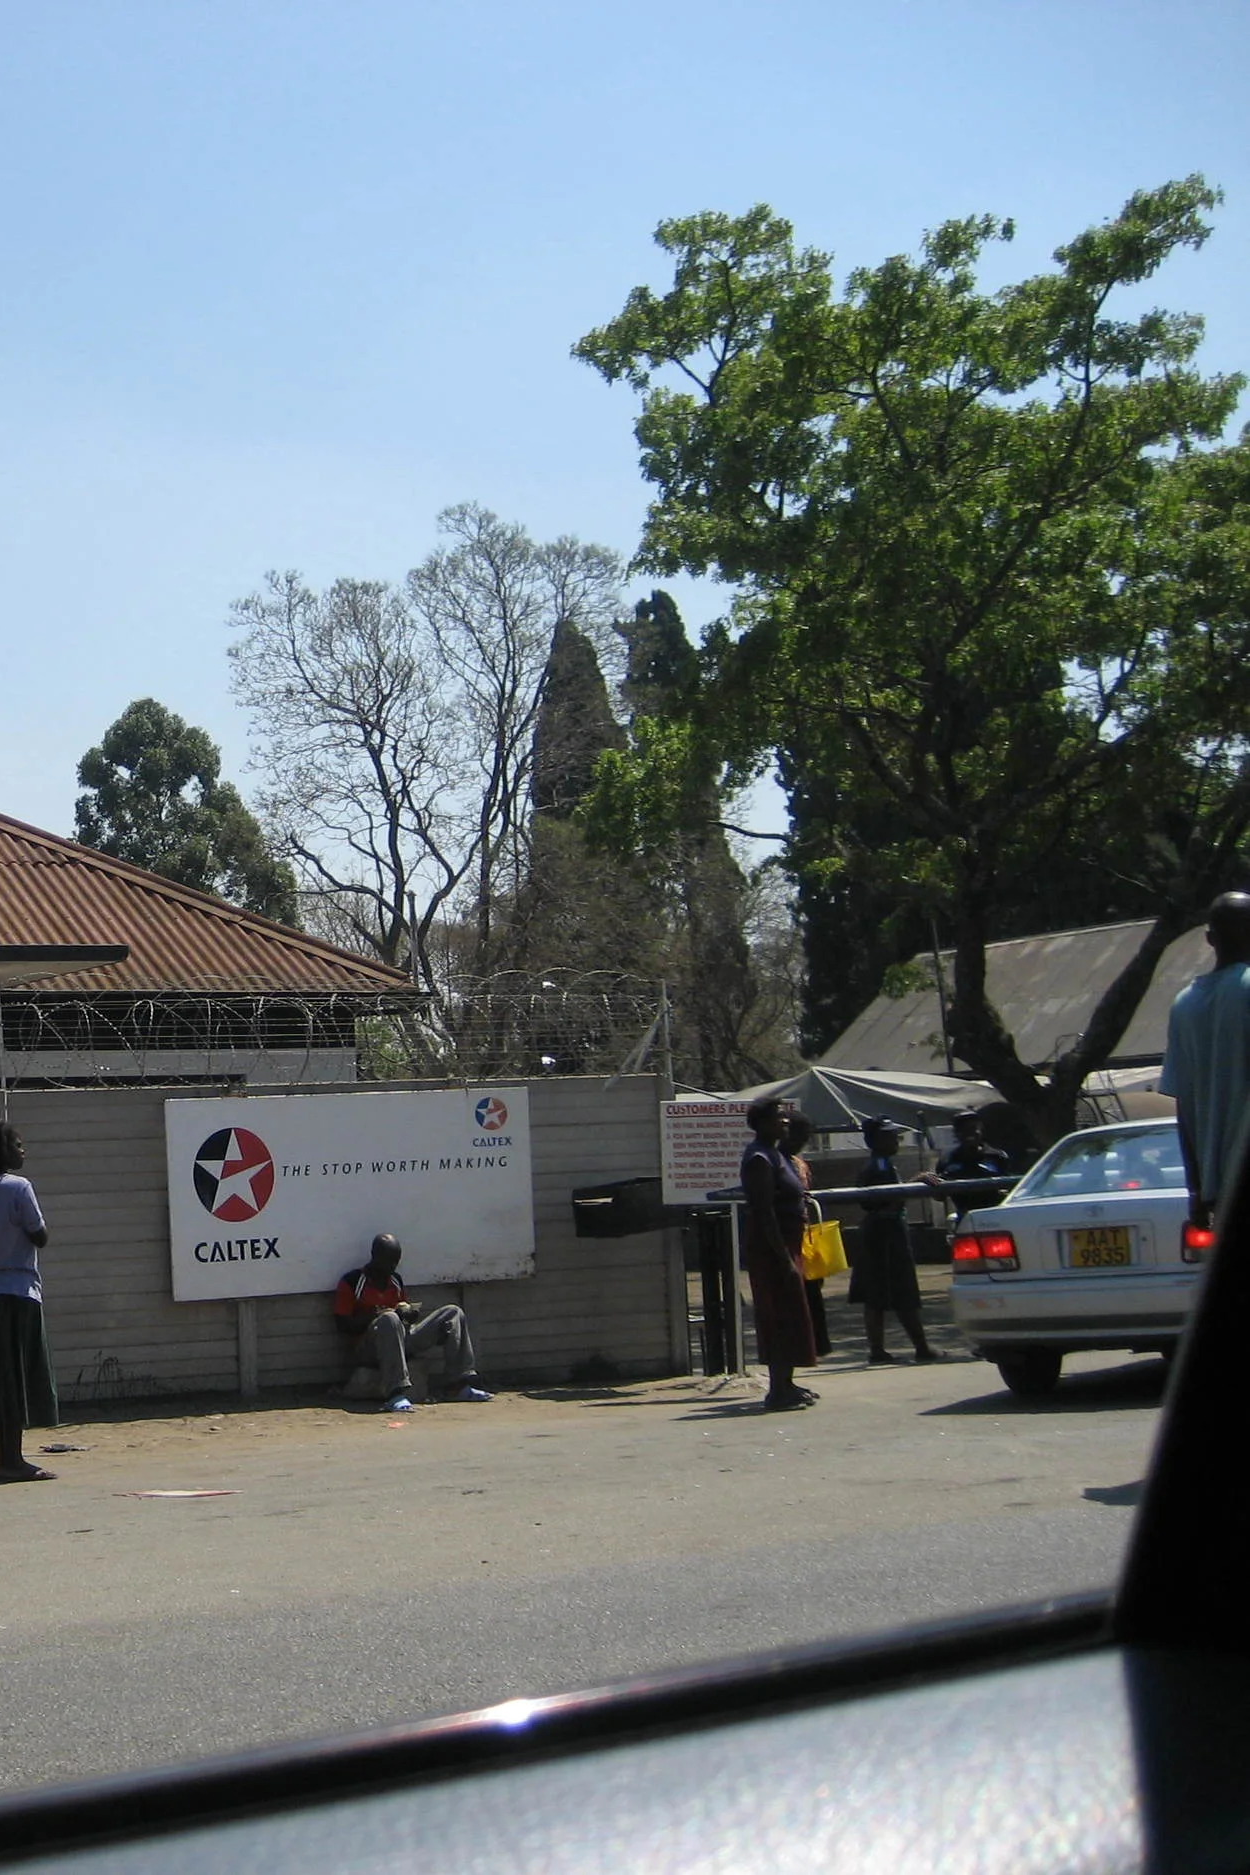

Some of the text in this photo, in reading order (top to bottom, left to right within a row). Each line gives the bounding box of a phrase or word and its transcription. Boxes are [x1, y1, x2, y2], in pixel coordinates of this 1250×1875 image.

[666, 1103, 726, 1115] CUSTOMERS
[729, 1102, 749, 1114] PLE
[472, 1136, 513, 1148] CALTEX
[282, 1156, 509, 1177] THE STOP WORTH MAKING
[194, 1237, 281, 1263] CALTEX
[1080, 1246, 1125, 1267] 9835
